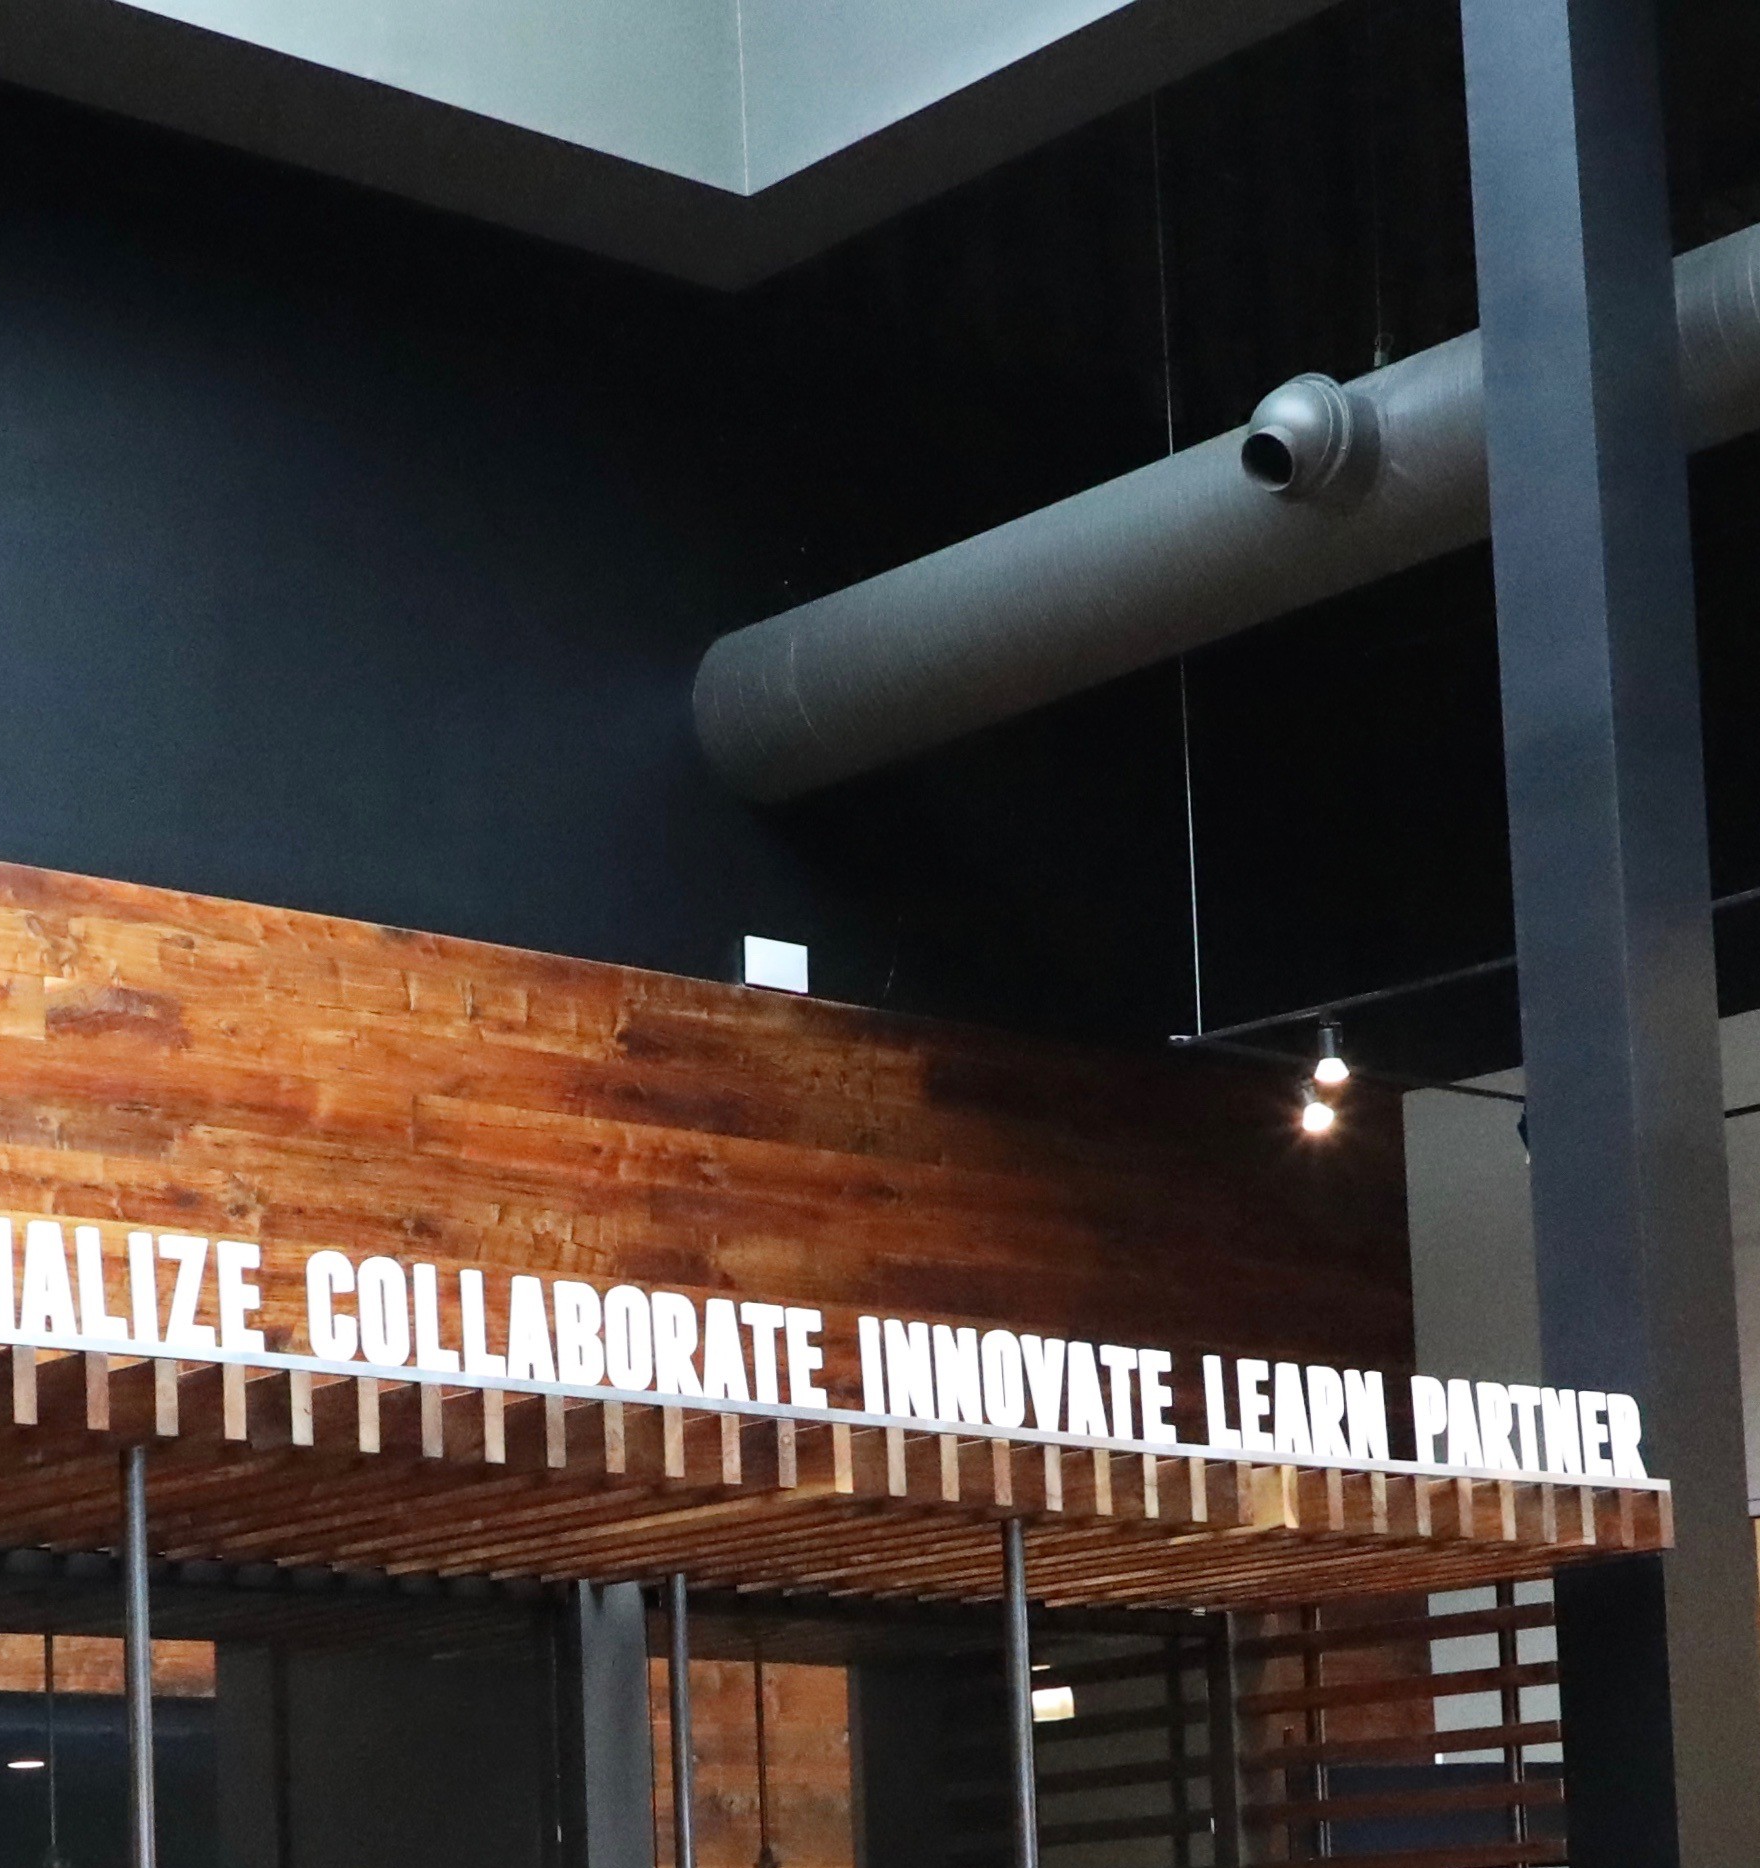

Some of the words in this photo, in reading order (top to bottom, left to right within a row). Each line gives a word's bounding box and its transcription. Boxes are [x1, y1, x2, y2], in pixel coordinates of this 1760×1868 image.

[305, 1249, 828, 1409] COLLABORATE
[857, 1314, 1177, 1445] INNOVATE
[1201, 1353, 1390, 1459] LEARN
[1410, 1374, 1648, 1479] PARTNER
